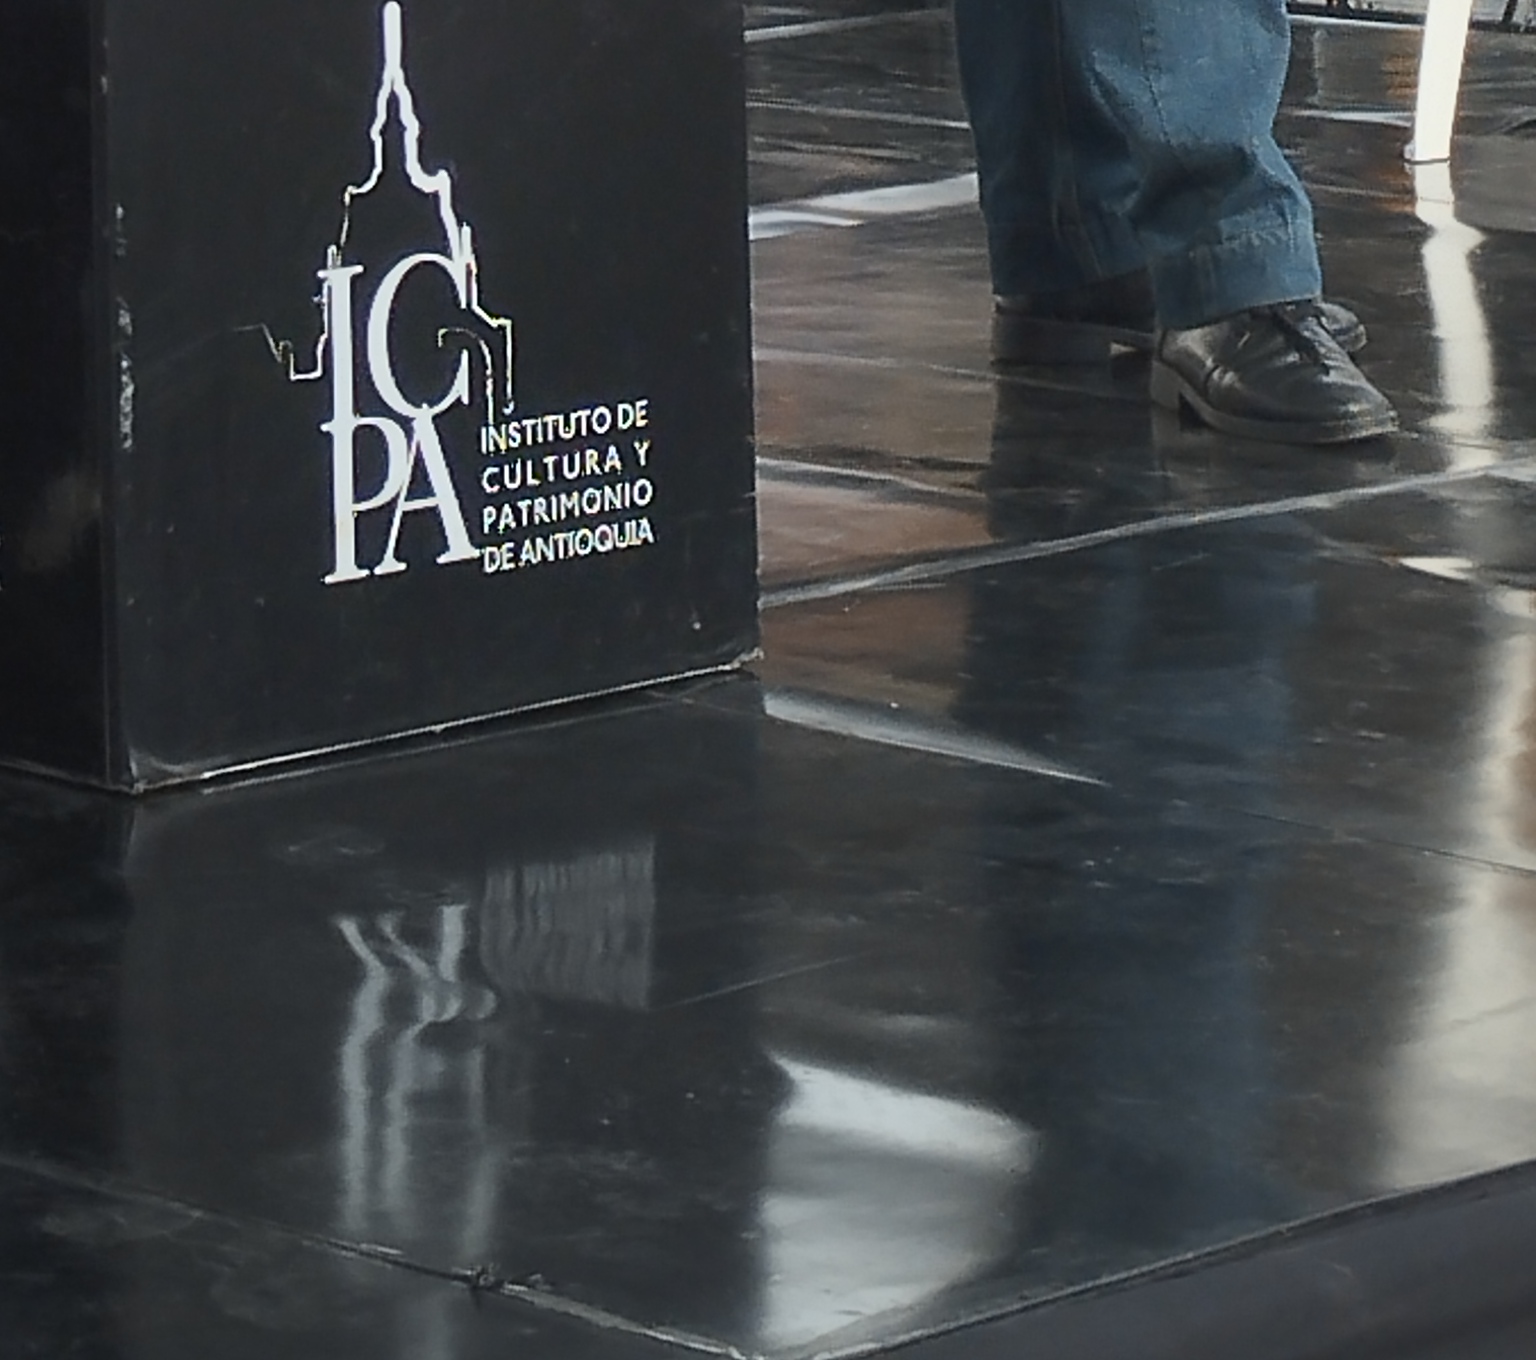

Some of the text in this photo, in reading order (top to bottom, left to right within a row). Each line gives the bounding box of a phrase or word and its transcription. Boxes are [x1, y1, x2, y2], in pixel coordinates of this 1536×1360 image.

[481, 399, 649, 455] INSTITUTO DE
[481, 439, 651, 493] CULTURA Y
[482, 478, 654, 534] PATRIMONIO
[483, 517, 655, 573] DE ANTIOQUIA
